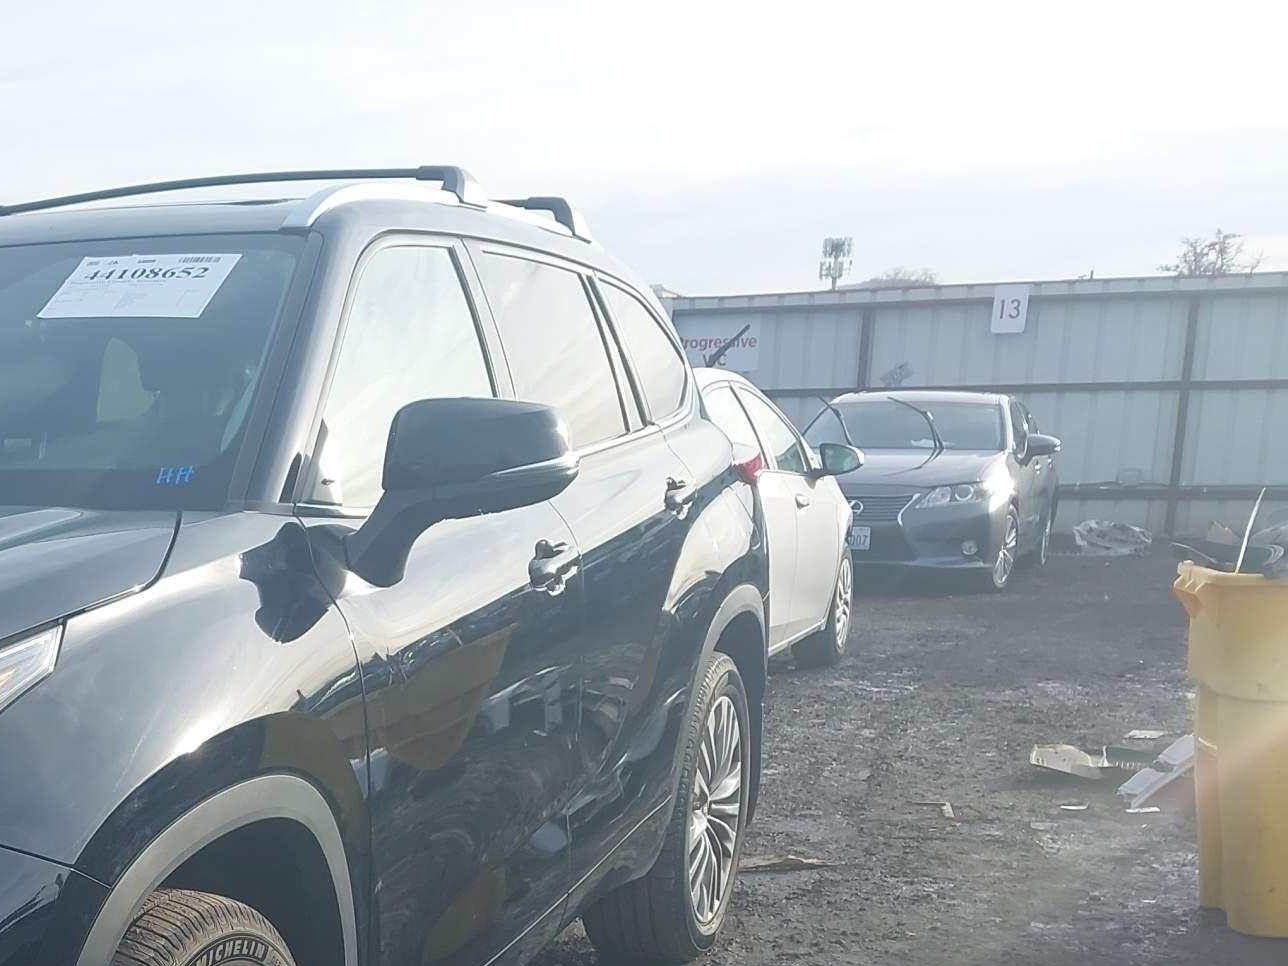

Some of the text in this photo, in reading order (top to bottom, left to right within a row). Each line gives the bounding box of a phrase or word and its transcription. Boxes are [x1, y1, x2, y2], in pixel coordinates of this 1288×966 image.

[85, 267, 209, 280] 44108652
[999, 299, 1021, 319] 13
[680, 336, 757, 351] rogresive
